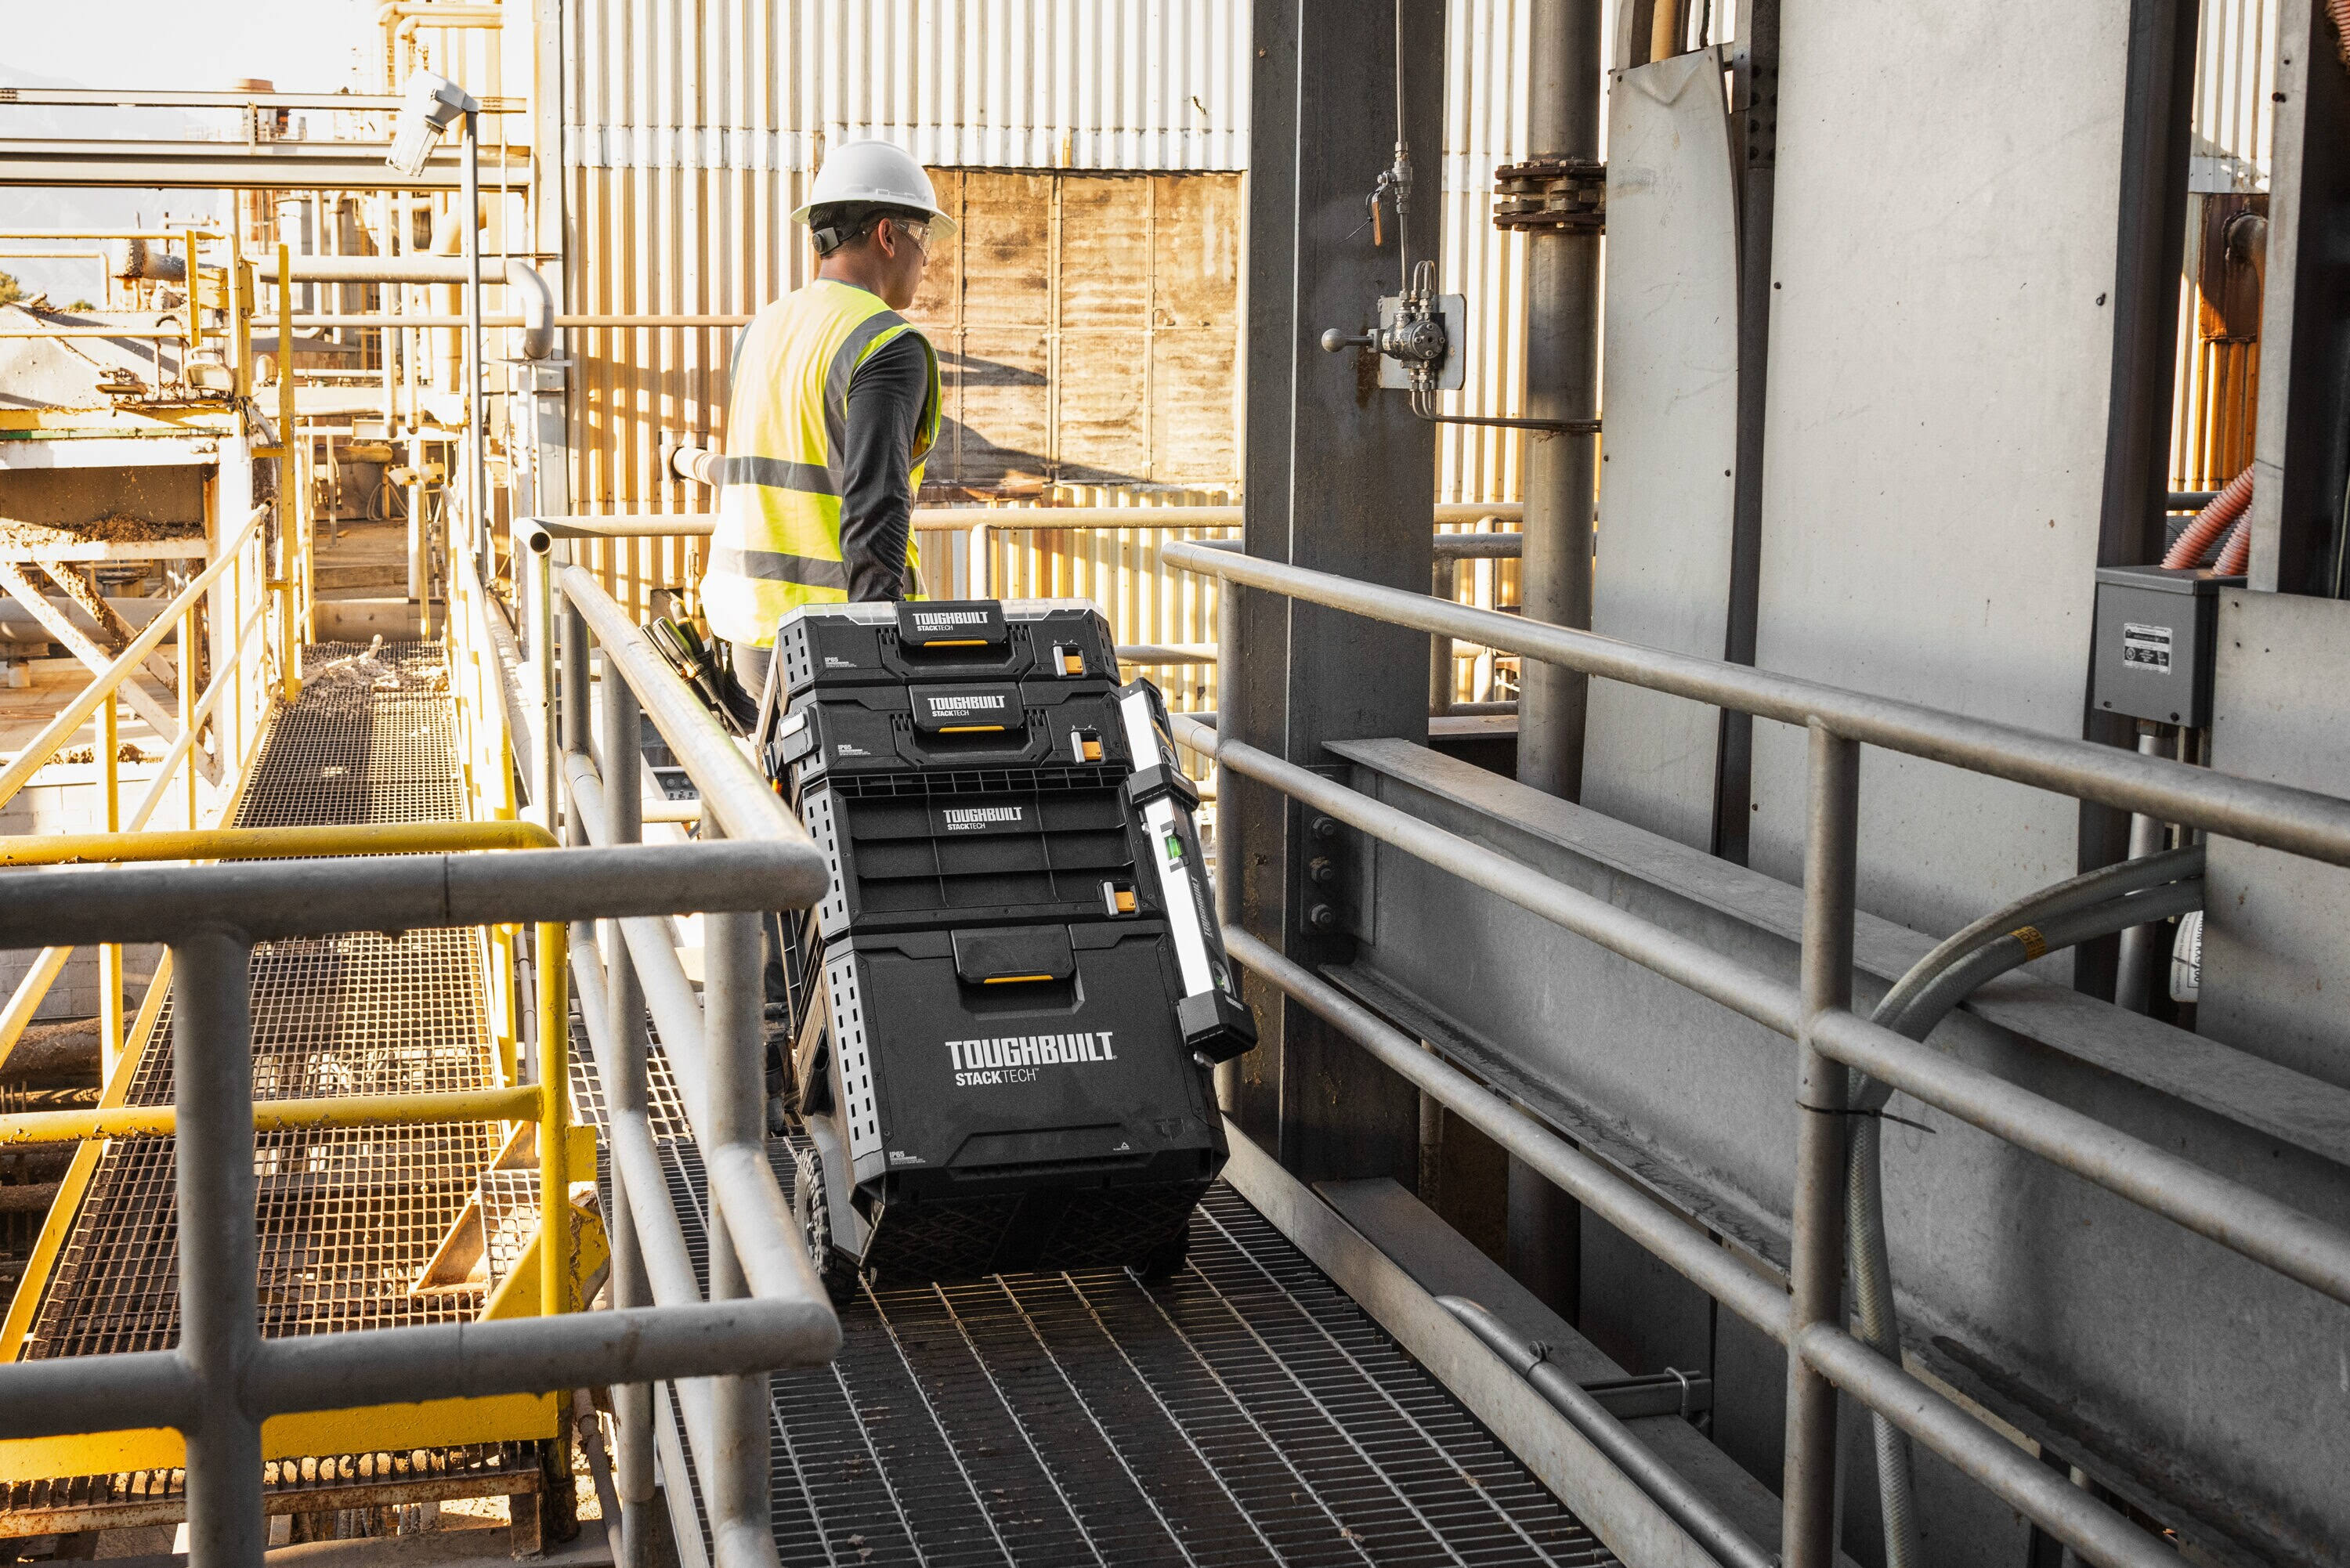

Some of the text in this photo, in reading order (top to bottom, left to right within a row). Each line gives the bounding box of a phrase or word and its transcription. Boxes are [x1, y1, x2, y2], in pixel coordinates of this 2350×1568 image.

[913, 612, 989, 626] TOUGHBUILT
[927, 695, 1005, 710] TOUGHBUILT
[943, 807, 1021, 823] TOUGHBUILT
[945, 1031, 1113, 1070] TOUGHBUILT
